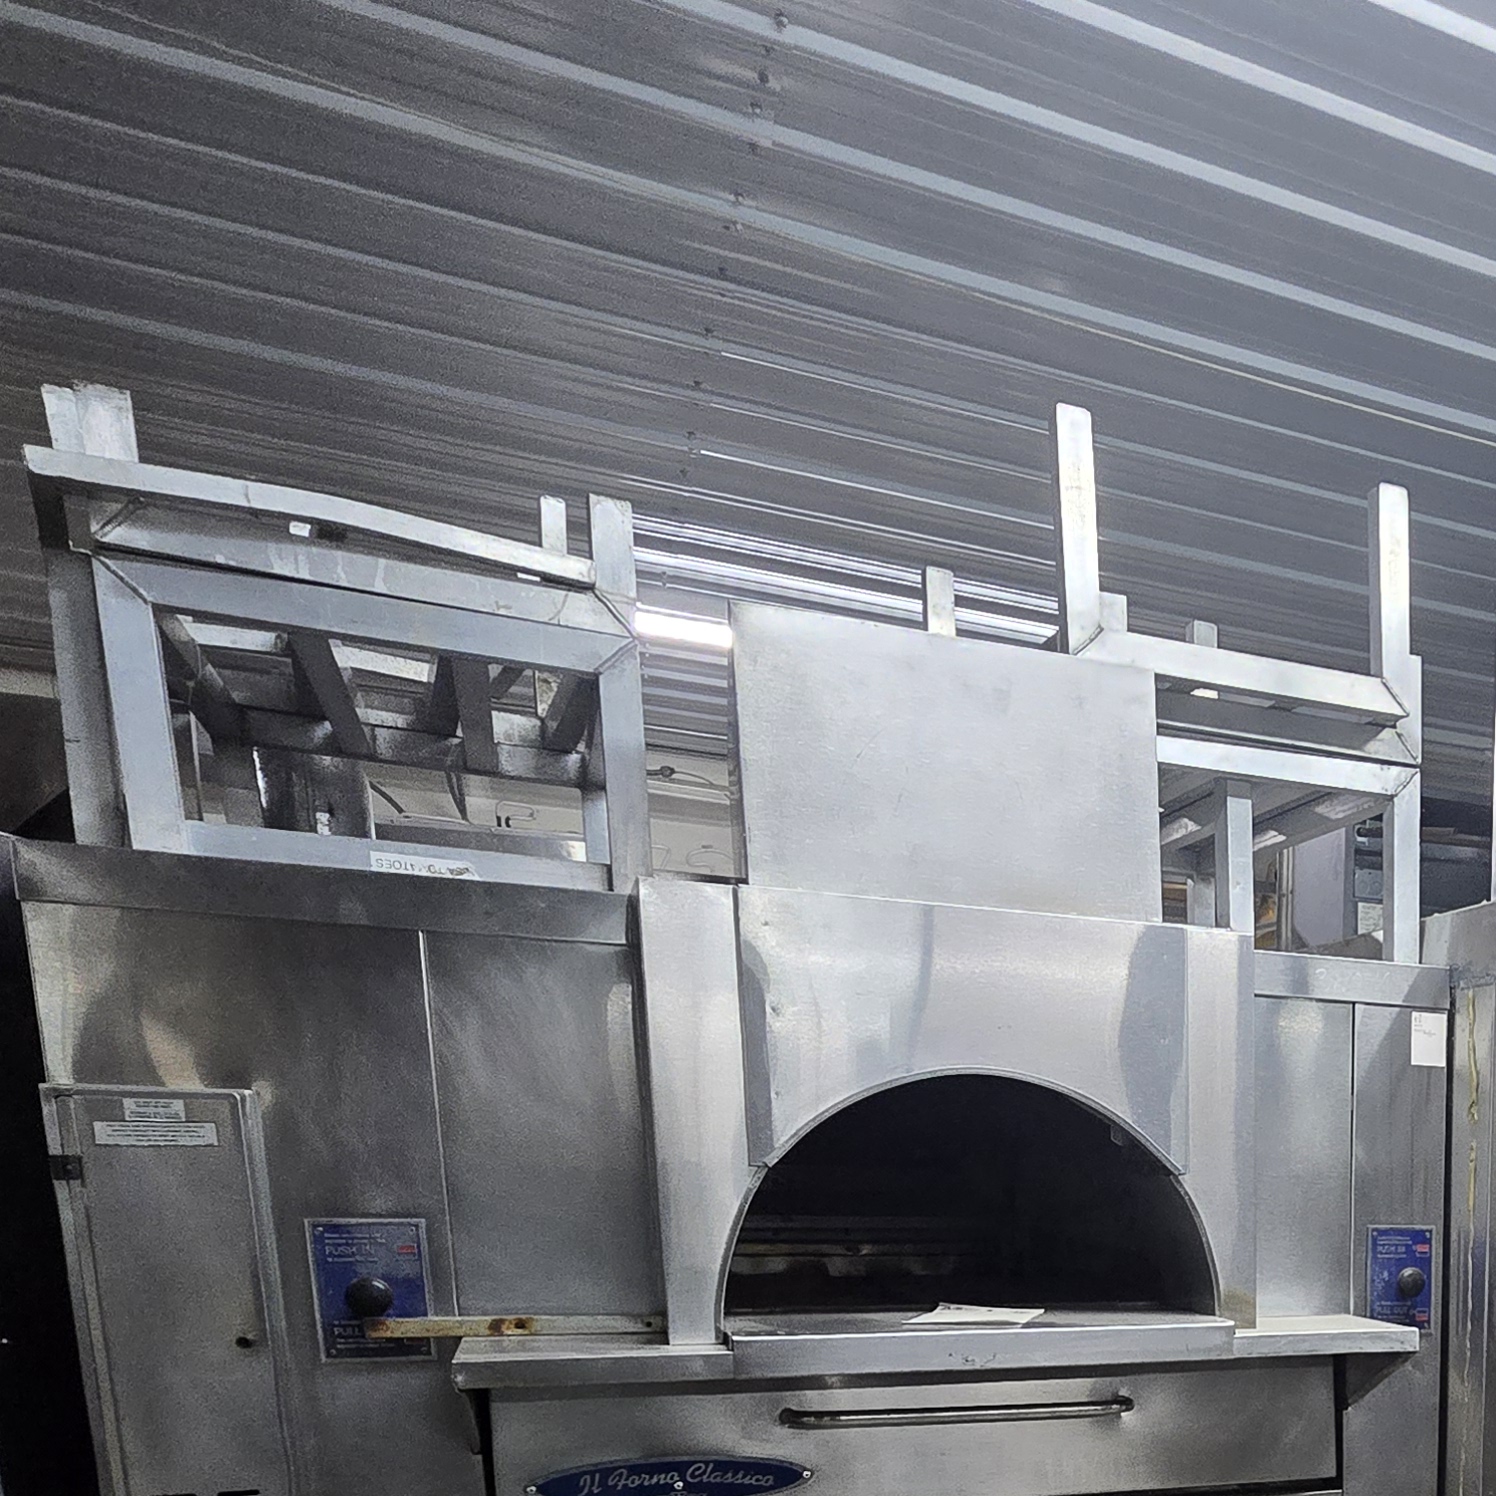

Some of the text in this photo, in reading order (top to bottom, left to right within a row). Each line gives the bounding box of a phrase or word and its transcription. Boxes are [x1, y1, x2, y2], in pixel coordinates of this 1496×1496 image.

[375, 857, 446, 876] TOATOES
[608, 1468, 680, 1491] Forno
[686, 1462, 775, 1487] Classico
